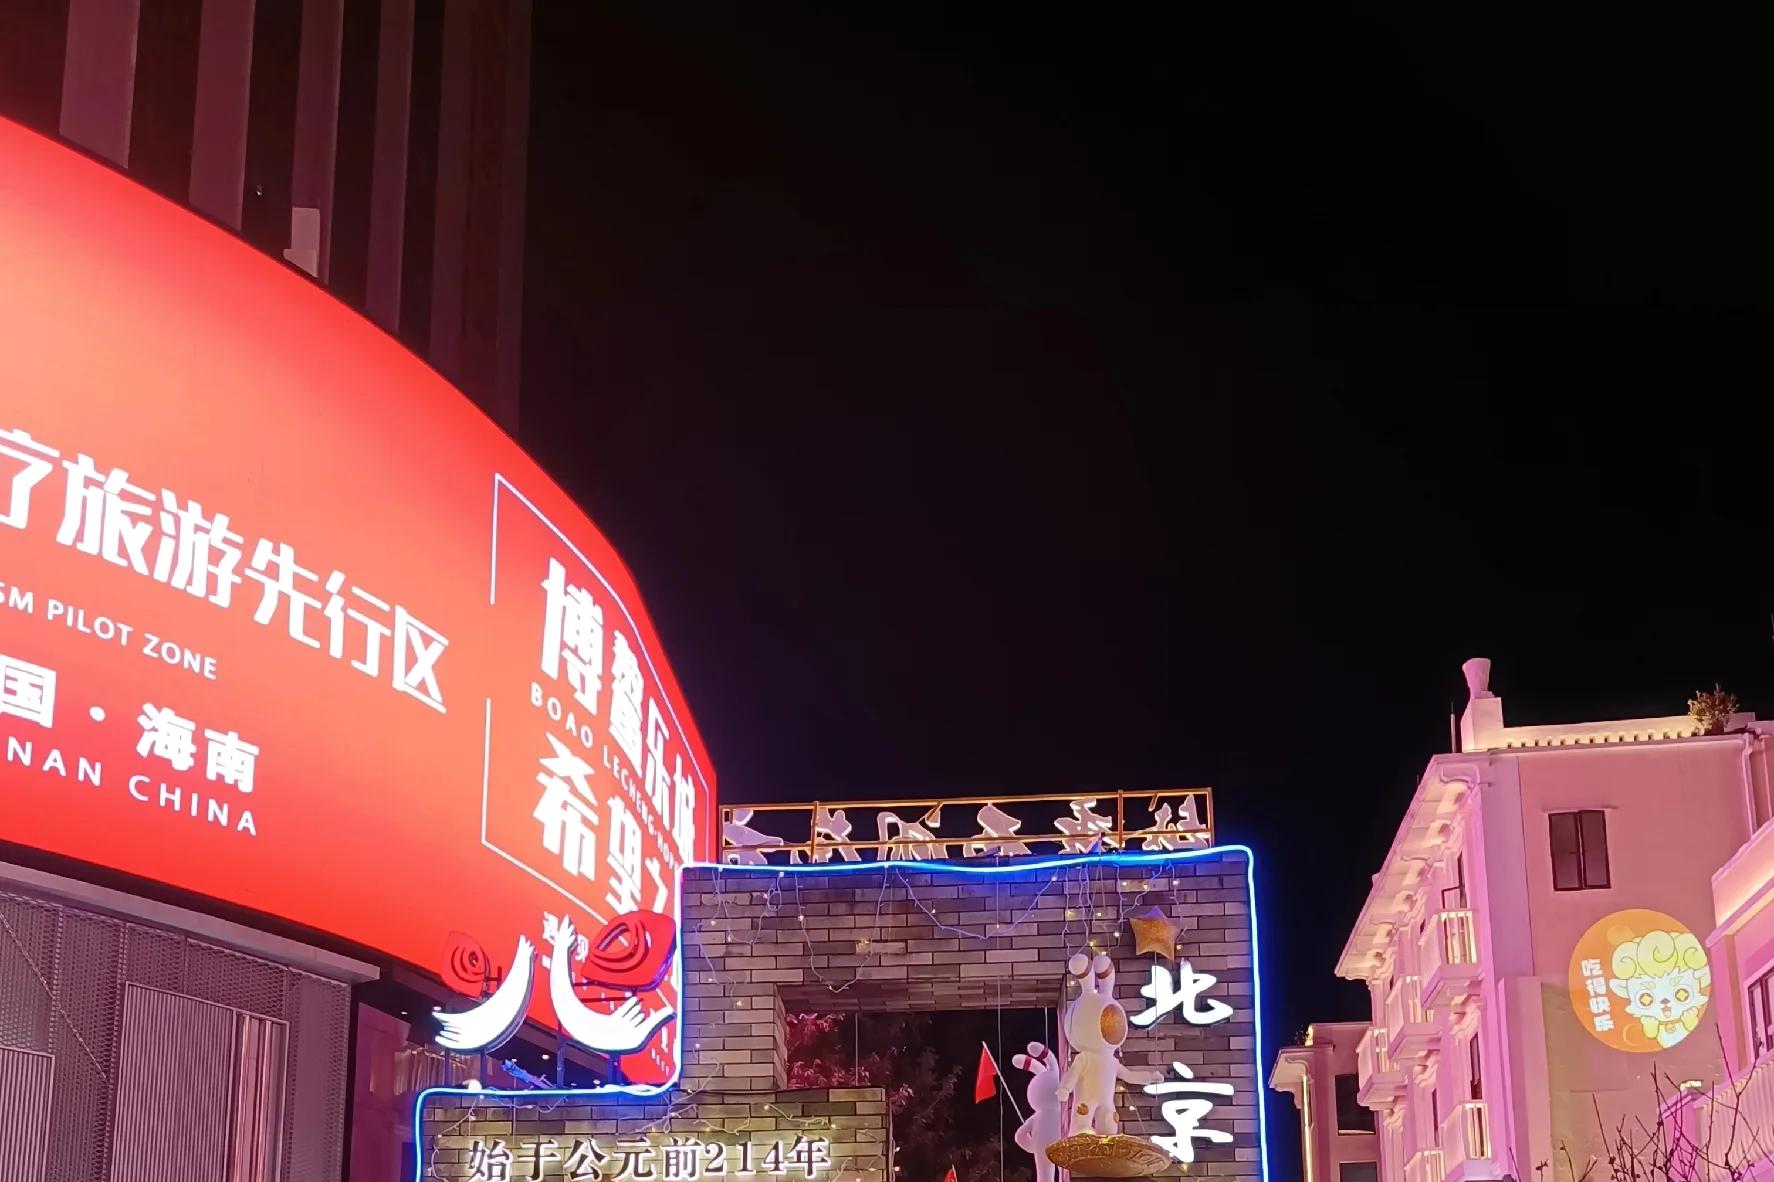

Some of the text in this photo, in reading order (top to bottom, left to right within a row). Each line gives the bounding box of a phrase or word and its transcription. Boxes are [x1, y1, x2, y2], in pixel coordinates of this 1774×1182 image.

[47, 598, 133, 647] PILOT
[143, 632, 217, 680] ZONE
[531, 682, 593, 748] BOAO
[7, 737, 257, 836] NAN CHINA
